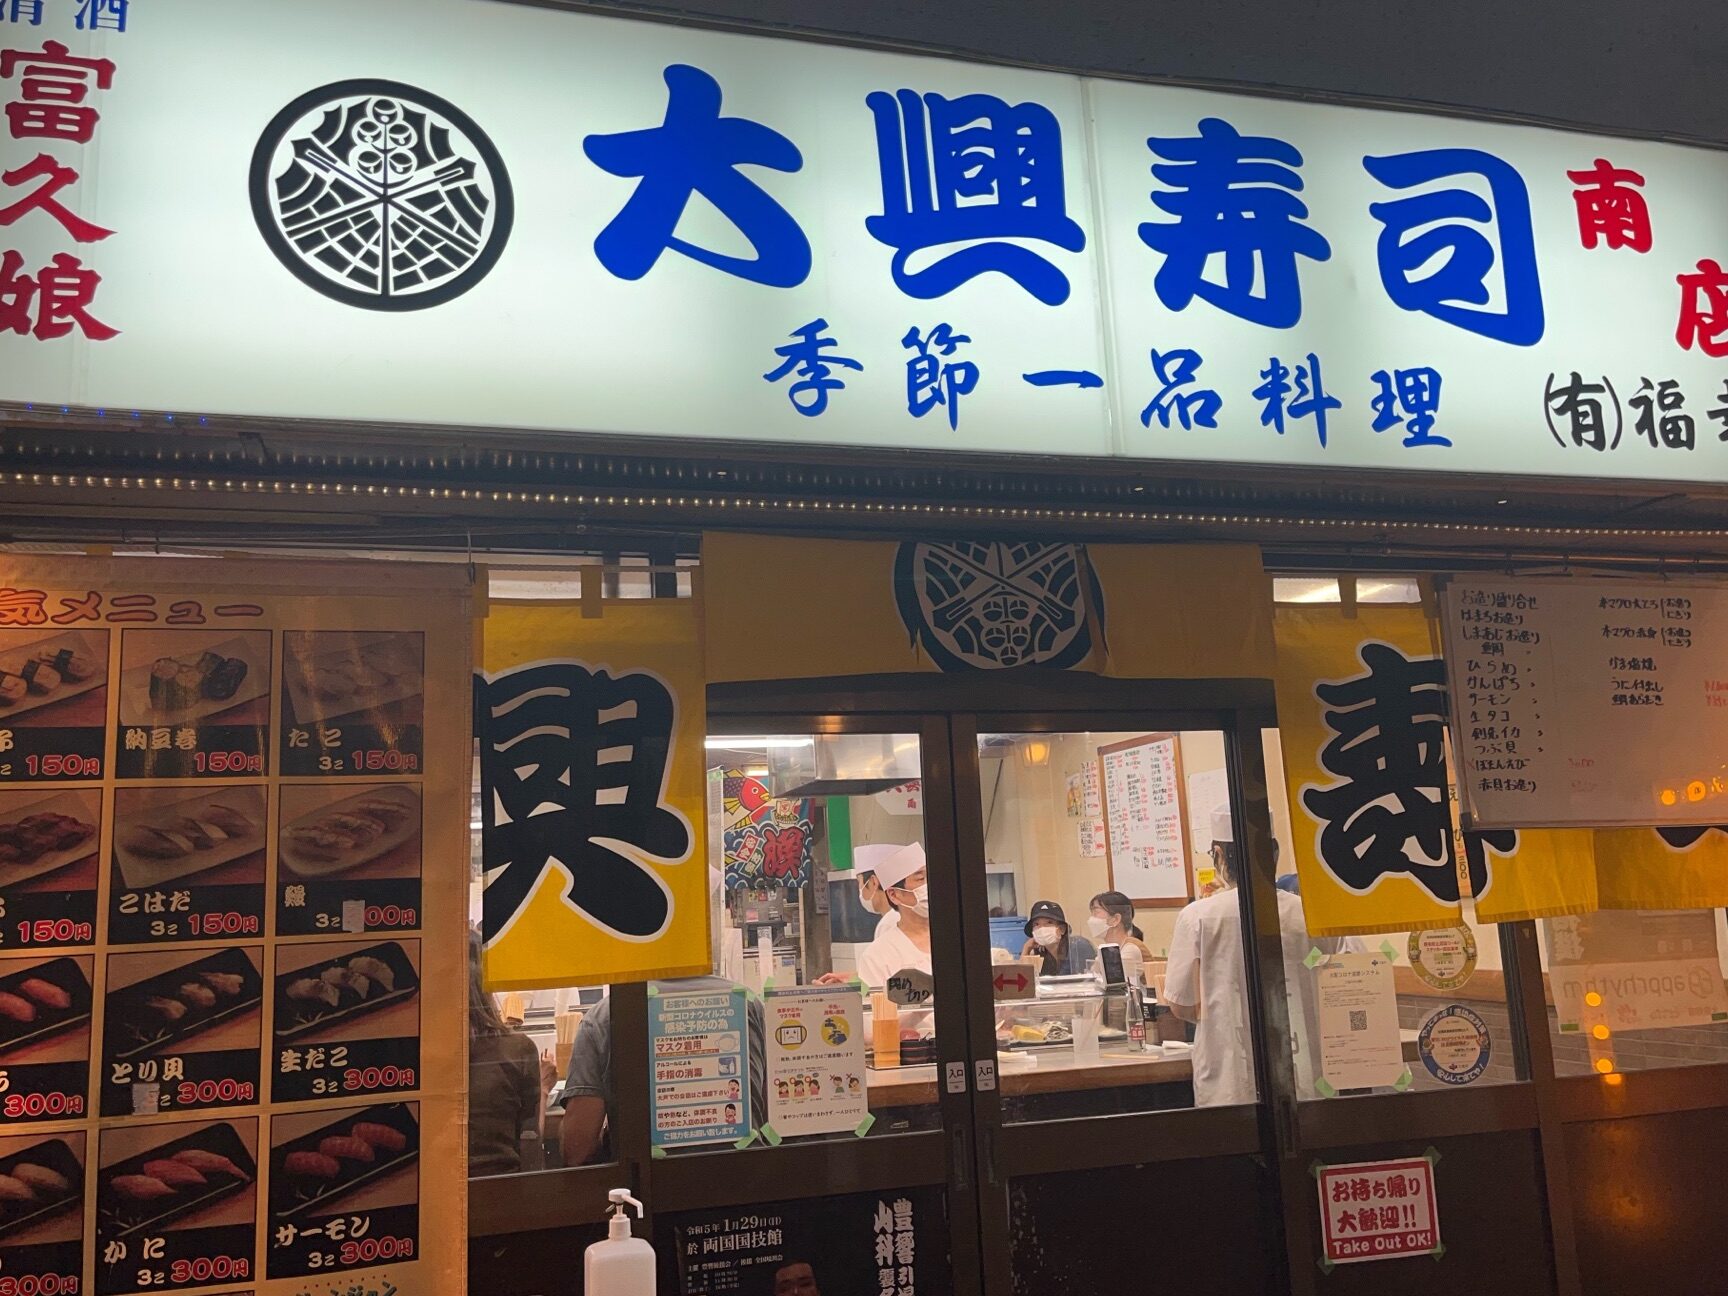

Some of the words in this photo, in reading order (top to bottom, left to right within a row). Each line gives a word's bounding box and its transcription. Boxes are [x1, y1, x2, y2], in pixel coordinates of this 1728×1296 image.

[583, 64, 1544, 347] 大興寿司
[763, 318, 1452, 450] 季節一品料理
[1467, 659, 1518, 681] ひらめ
[1467, 675, 1520, 696] かんぱち
[1468, 692, 1512, 707] サーモン
[125, 728, 197, 750] 納豆巻
[288, 728, 342, 748] たこ
[1474, 740, 1518, 755] つぶ貝
[25, 753, 100, 777] 150円
[194, 751, 263, 773] 150円
[351, 749, 418, 770] 150円
[119, 890, 191, 914] こはだ
[17, 918, 92, 943] 150円
[187, 912, 259, 936] 150円
[656, 1040, 702, 1053] マスク着用
[111, 1057, 184, 1084] とり貝
[342, 1065, 415, 1091] 300円
[656, 1068, 703, 1080] 手指の消毒
[948, 1068, 964, 1080] 入口
[977, 1066, 993, 1077] 入口
[176, 1078, 254, 1105] 300円
[3, 1091, 84, 1118] 300円
[1332, 1174, 1421, 1202] お持ち帰り
[1337, 1204, 1417, 1233] 大歓迎!!
[274, 1216, 370, 1248] サーモン
[702, 1229, 783, 1255] 両国国技館
[1332, 1241, 1370, 1255] Take
[1374, 1236, 1402, 1250] Out
[1406, 1231, 1432, 1248] OK!
[103, 1237, 166, 1264] かに
[339, 1235, 413, 1265] 300円
[170, 1255, 250, 1283] 300円
[0, 1272, 80, 1296] 300円
